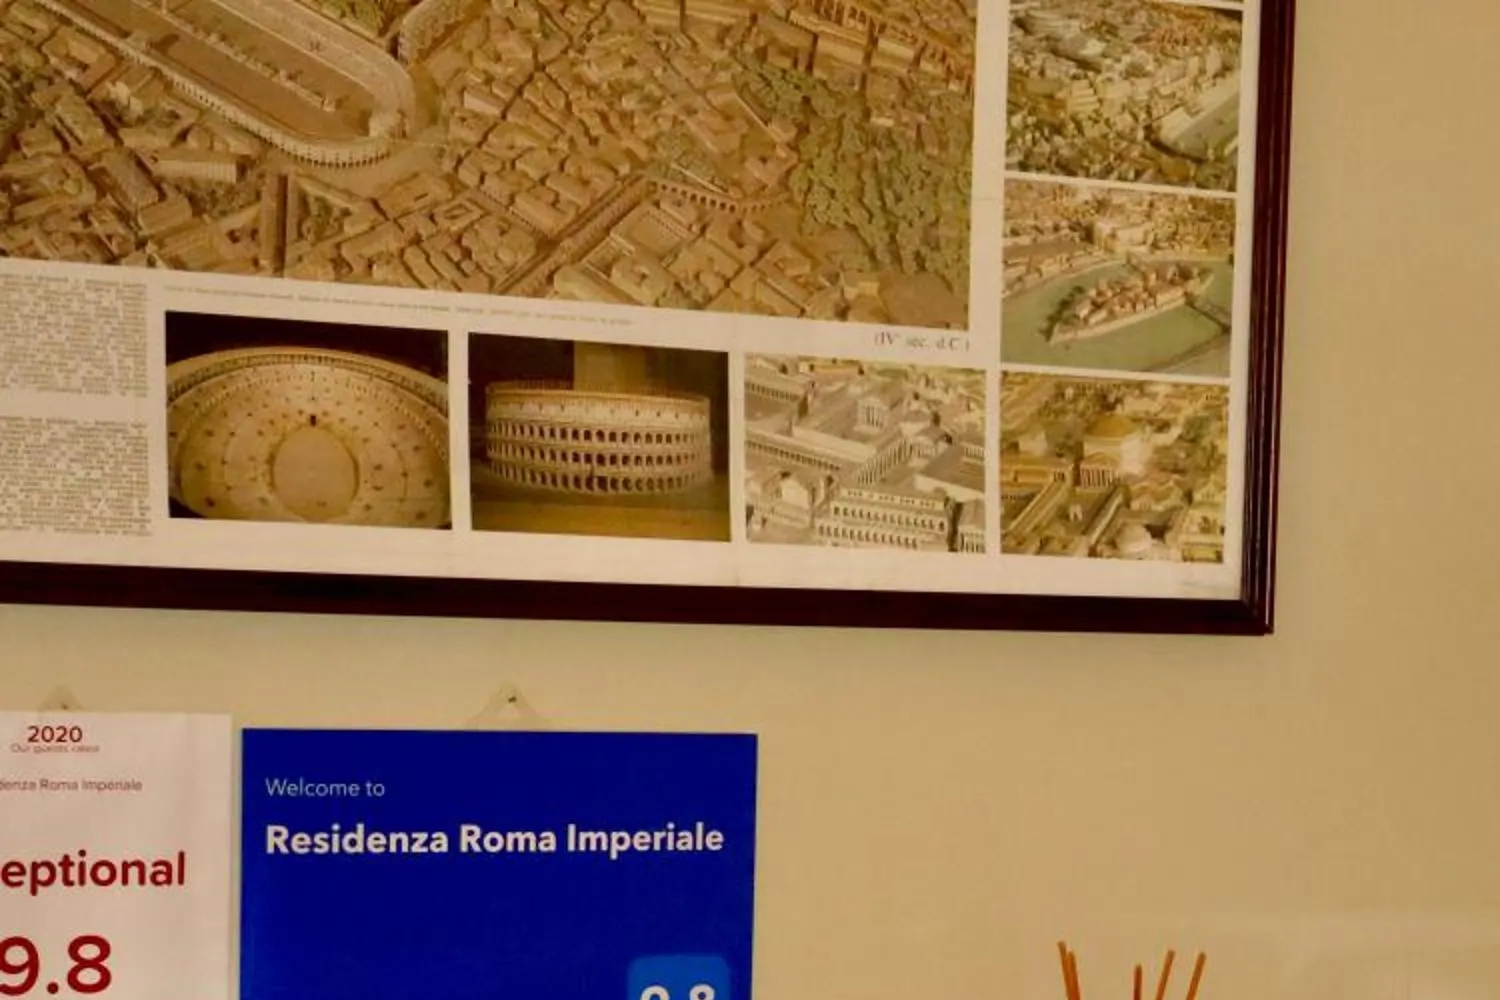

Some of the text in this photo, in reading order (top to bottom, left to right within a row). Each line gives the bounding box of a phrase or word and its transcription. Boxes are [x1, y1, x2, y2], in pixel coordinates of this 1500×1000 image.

[27, 725, 83, 743] 2020
[39, 778, 78, 791] Roma
[82, 778, 143, 794] Imperiale
[265, 777, 386, 797] Welcome to
[265, 822, 725, 860] Residenza Roma Imperiale
[0, 848, 186, 897] eptional
[0, 935, 112, 997] 9.8
